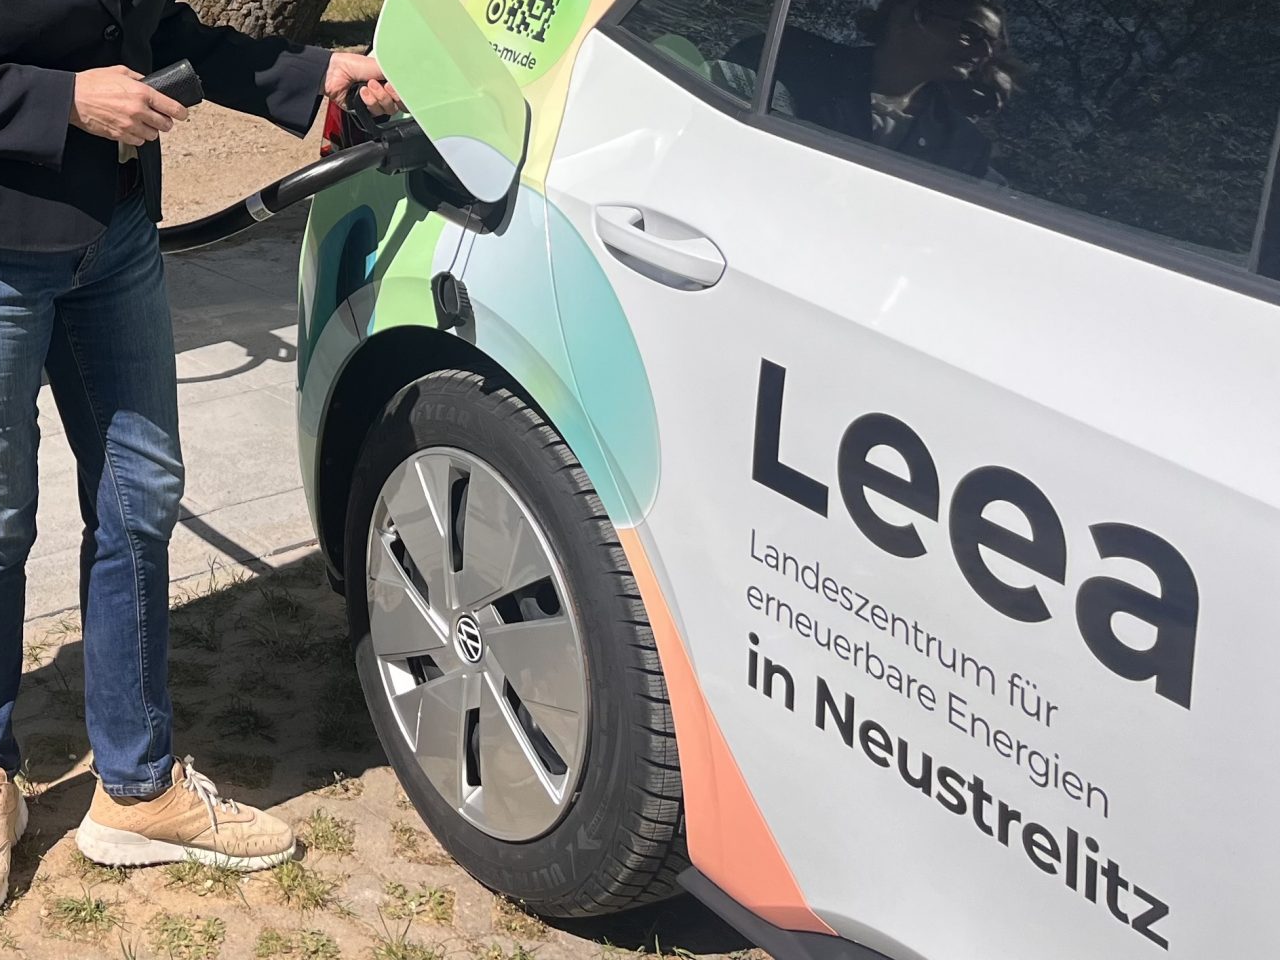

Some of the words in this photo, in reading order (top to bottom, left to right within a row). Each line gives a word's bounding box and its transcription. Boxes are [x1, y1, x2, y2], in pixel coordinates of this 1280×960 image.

[489, 41, 537, 70] a-mv.de
[750, 528, 997, 696] Landeszentrum
[1007, 672, 1060, 728] für
[751, 357, 1200, 711] Leea
[746, 585, 938, 713] erneuerbare
[947, 691, 1110, 819] Energien
[747, 631, 795, 713] in
[815, 675, 1170, 952] Neustrelitz
